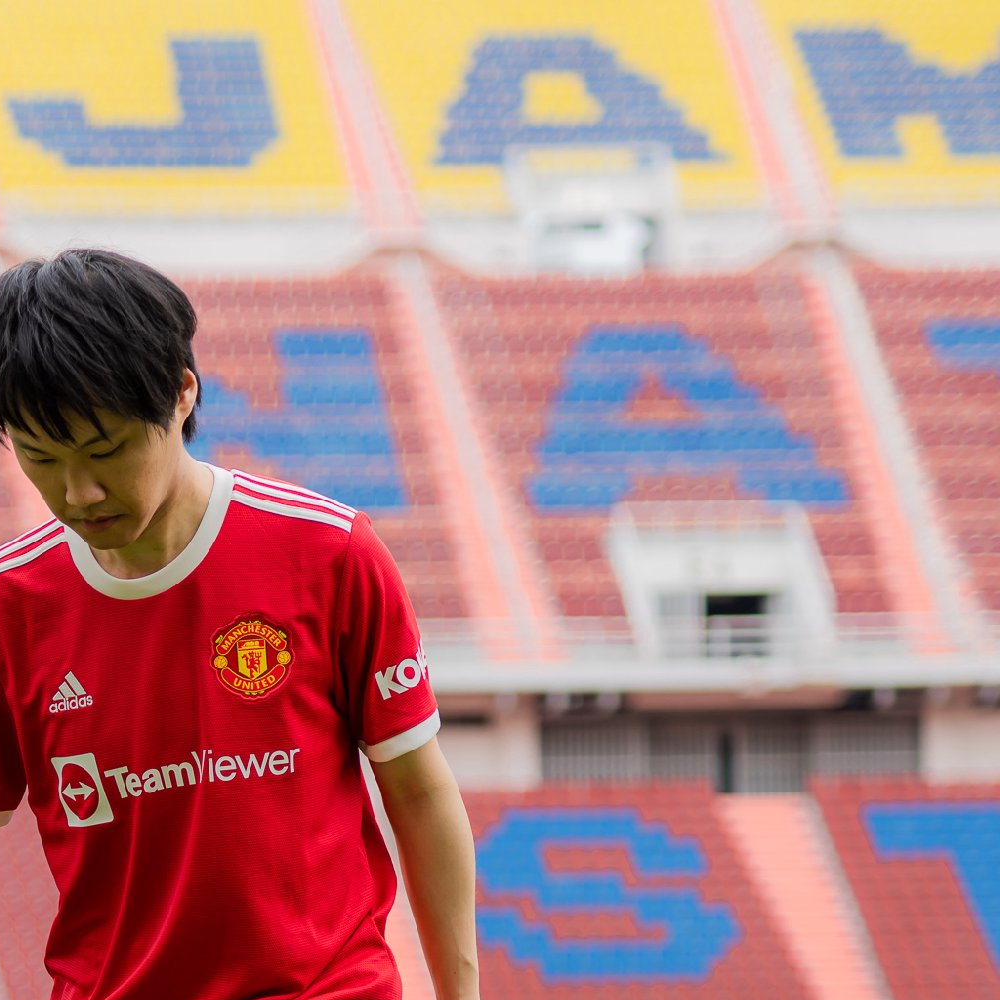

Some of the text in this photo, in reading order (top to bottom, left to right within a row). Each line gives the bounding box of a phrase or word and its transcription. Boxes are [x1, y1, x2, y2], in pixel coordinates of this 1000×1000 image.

[221, 624, 281, 651] MANCHESTER
[233, 675, 275, 690] UNITED
[49, 695, 93, 713] adidas
[104, 748, 300, 799] TeamViewer
